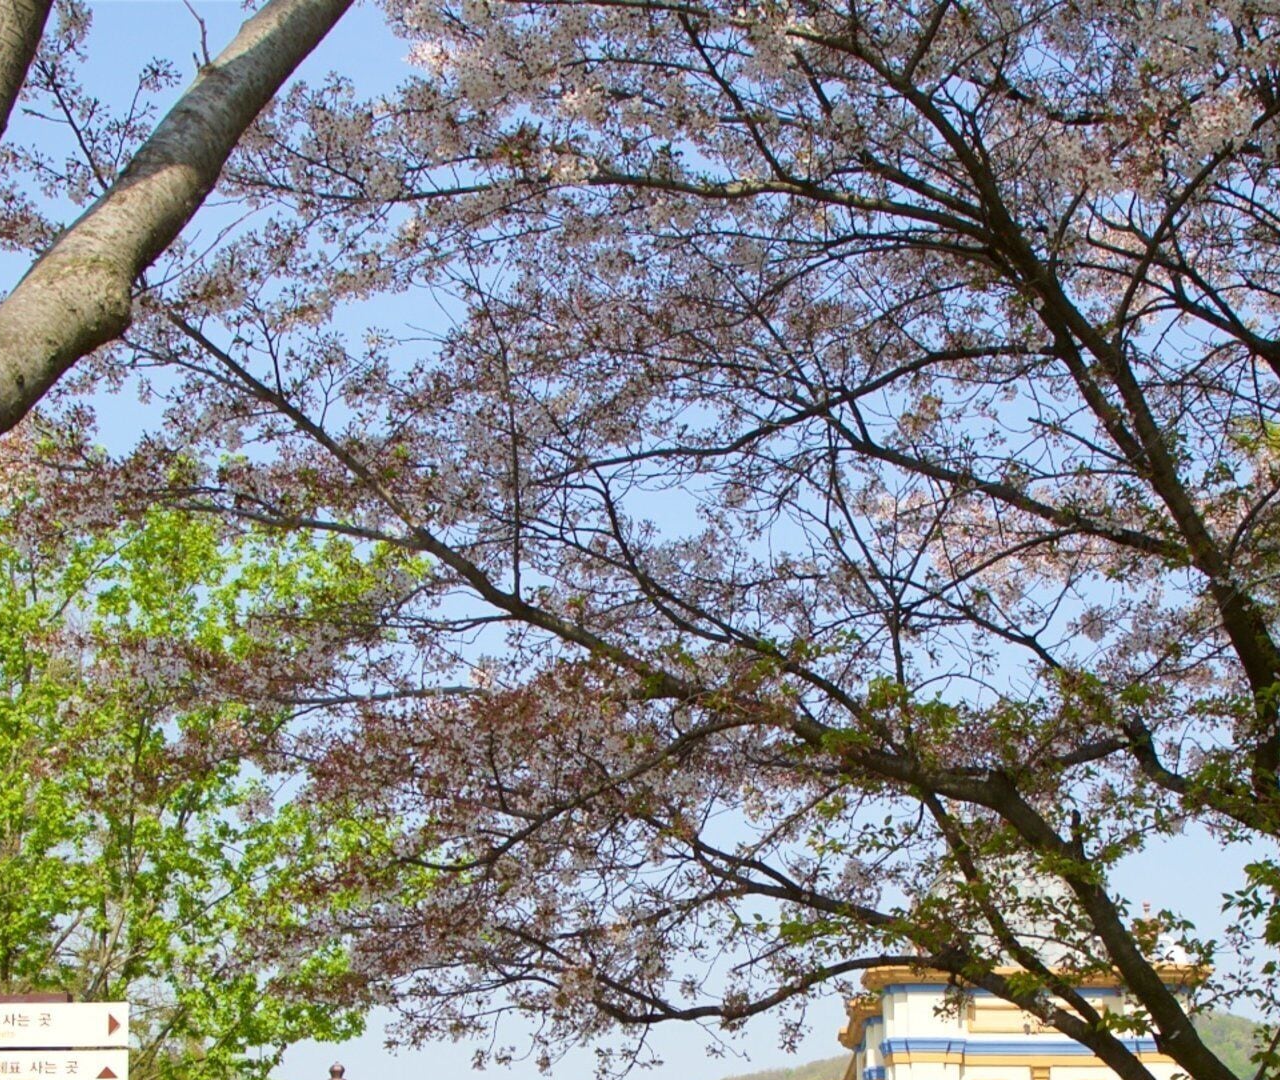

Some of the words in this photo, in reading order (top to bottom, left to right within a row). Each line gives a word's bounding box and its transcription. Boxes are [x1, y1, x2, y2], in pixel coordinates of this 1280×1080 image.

[3, 1013, 30, 1027] 사는
[38, 1012, 52, 1027] 곳
[30, 1061, 57, 1074] 사는
[65, 1060, 78, 1074] 곳
